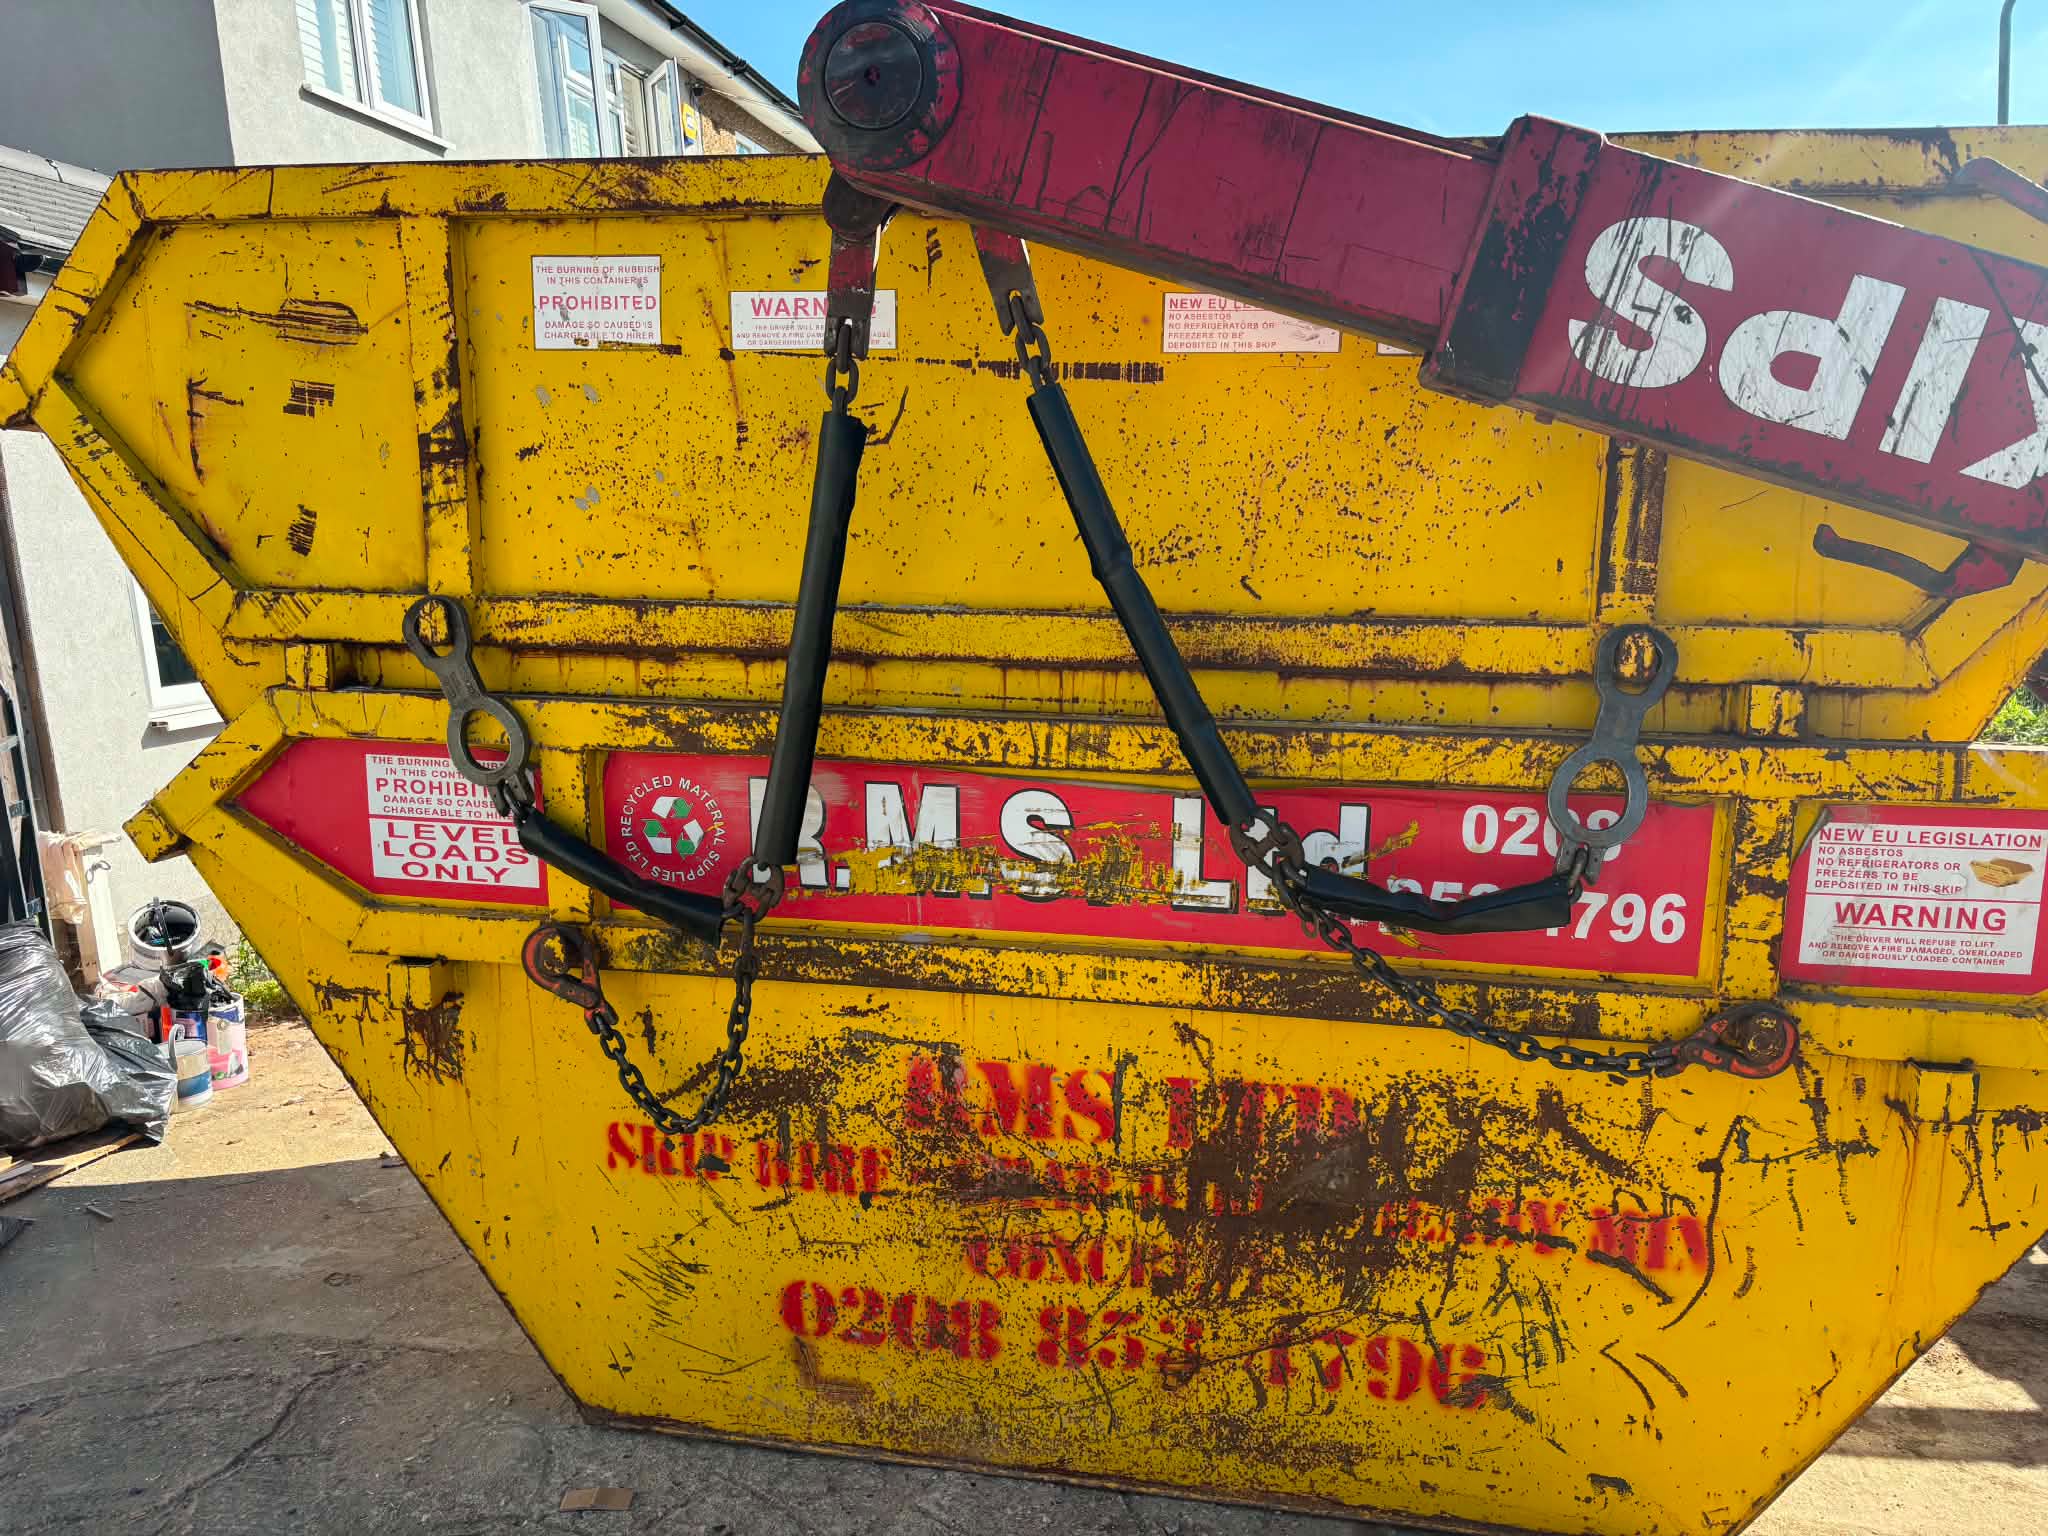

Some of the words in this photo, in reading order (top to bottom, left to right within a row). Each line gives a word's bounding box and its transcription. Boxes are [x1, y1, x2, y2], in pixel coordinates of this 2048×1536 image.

[536, 265, 554, 274] THE
[556, 265, 599, 274] BURNING
[602, 266, 615, 274] OF
[618, 264, 660, 273] RUBBISH
[547, 277, 557, 285] IN
[560, 277, 581, 285] THIS
[583, 277, 638, 285] CONTAINER
[539, 295, 657, 310] PROHIBITED
[750, 297, 876, 318] WARN
[1169, 298, 1203, 309] NEW
[1208, 299, 1227, 310] EU
[545, 321, 584, 329] DAMAGE
[587, 321, 600, 329] SO
[604, 321, 641, 329] CAUSED
[544, 331, 608, 340] CHARGEABLE
[612, 331, 623, 339] TO
[626, 331, 654, 339] HIRER
[372, 756, 393, 765] THE
[397, 757, 450, 768] BURNING
[385, 767, 397, 776] IN
[402, 768, 427, 777] THIS
[383, 794, 432, 806] DAMAGE
[436, 798, 453, 807] SO
[456, 799, 496, 809] CAUSE
[620, 775, 673, 837] RECYCLED
[383, 805, 462, 818] CHARGEABLE
[468, 810, 482, 819] TO
[679, 777, 727, 846] MATERIAL
[387, 822, 521, 846] LEVEL
[1819, 828, 1865, 842] NEW
[1872, 829, 1898, 843] EU
[1907, 831, 2042, 849] LEGISLATION
[383, 840, 530, 865] LOADS
[625, 841, 649, 869] LTD
[1818, 846, 1835, 855] NO
[1838, 847, 1904, 857] ASBESTOS
[650, 850, 720, 882] SUPPLIES
[1817, 857, 1834, 866] NO
[1838, 858, 1939, 871] REFRIGERATORS
[1943, 862, 1961, 872] OR
[401, 861, 510, 884] ONLY
[1815, 868, 1878, 880] FREEZERS
[1883, 870, 1898, 880] TO
[1902, 872, 1919, 881] BE
[1814, 879, 1882, 891] DEPOSITED
[1886, 883, 1898, 892] IN
[1903, 884, 1929, 893] THIS
[1933, 884, 1963, 895] SKIP
[1834, 901, 2007, 932] WARNING
[1855, 935, 1892, 945] DRIVER
[1894, 937, 1917, 945] WILL
[1919, 938, 1957, 947] REFUSE
[1975, 940, 1995, 949] LIFT
[1808, 941, 1828, 950] AND
[1830, 942, 1870, 951] REMOVE
[1958, 948, 2023, 959] OVERLOADED
[1822, 950, 1836, 958] OR
[1838, 951, 1908, 961] DANGEROUSLY
[1910, 955, 1950, 964] LOADED
[1952, 957, 2006, 967] CONTAINER
